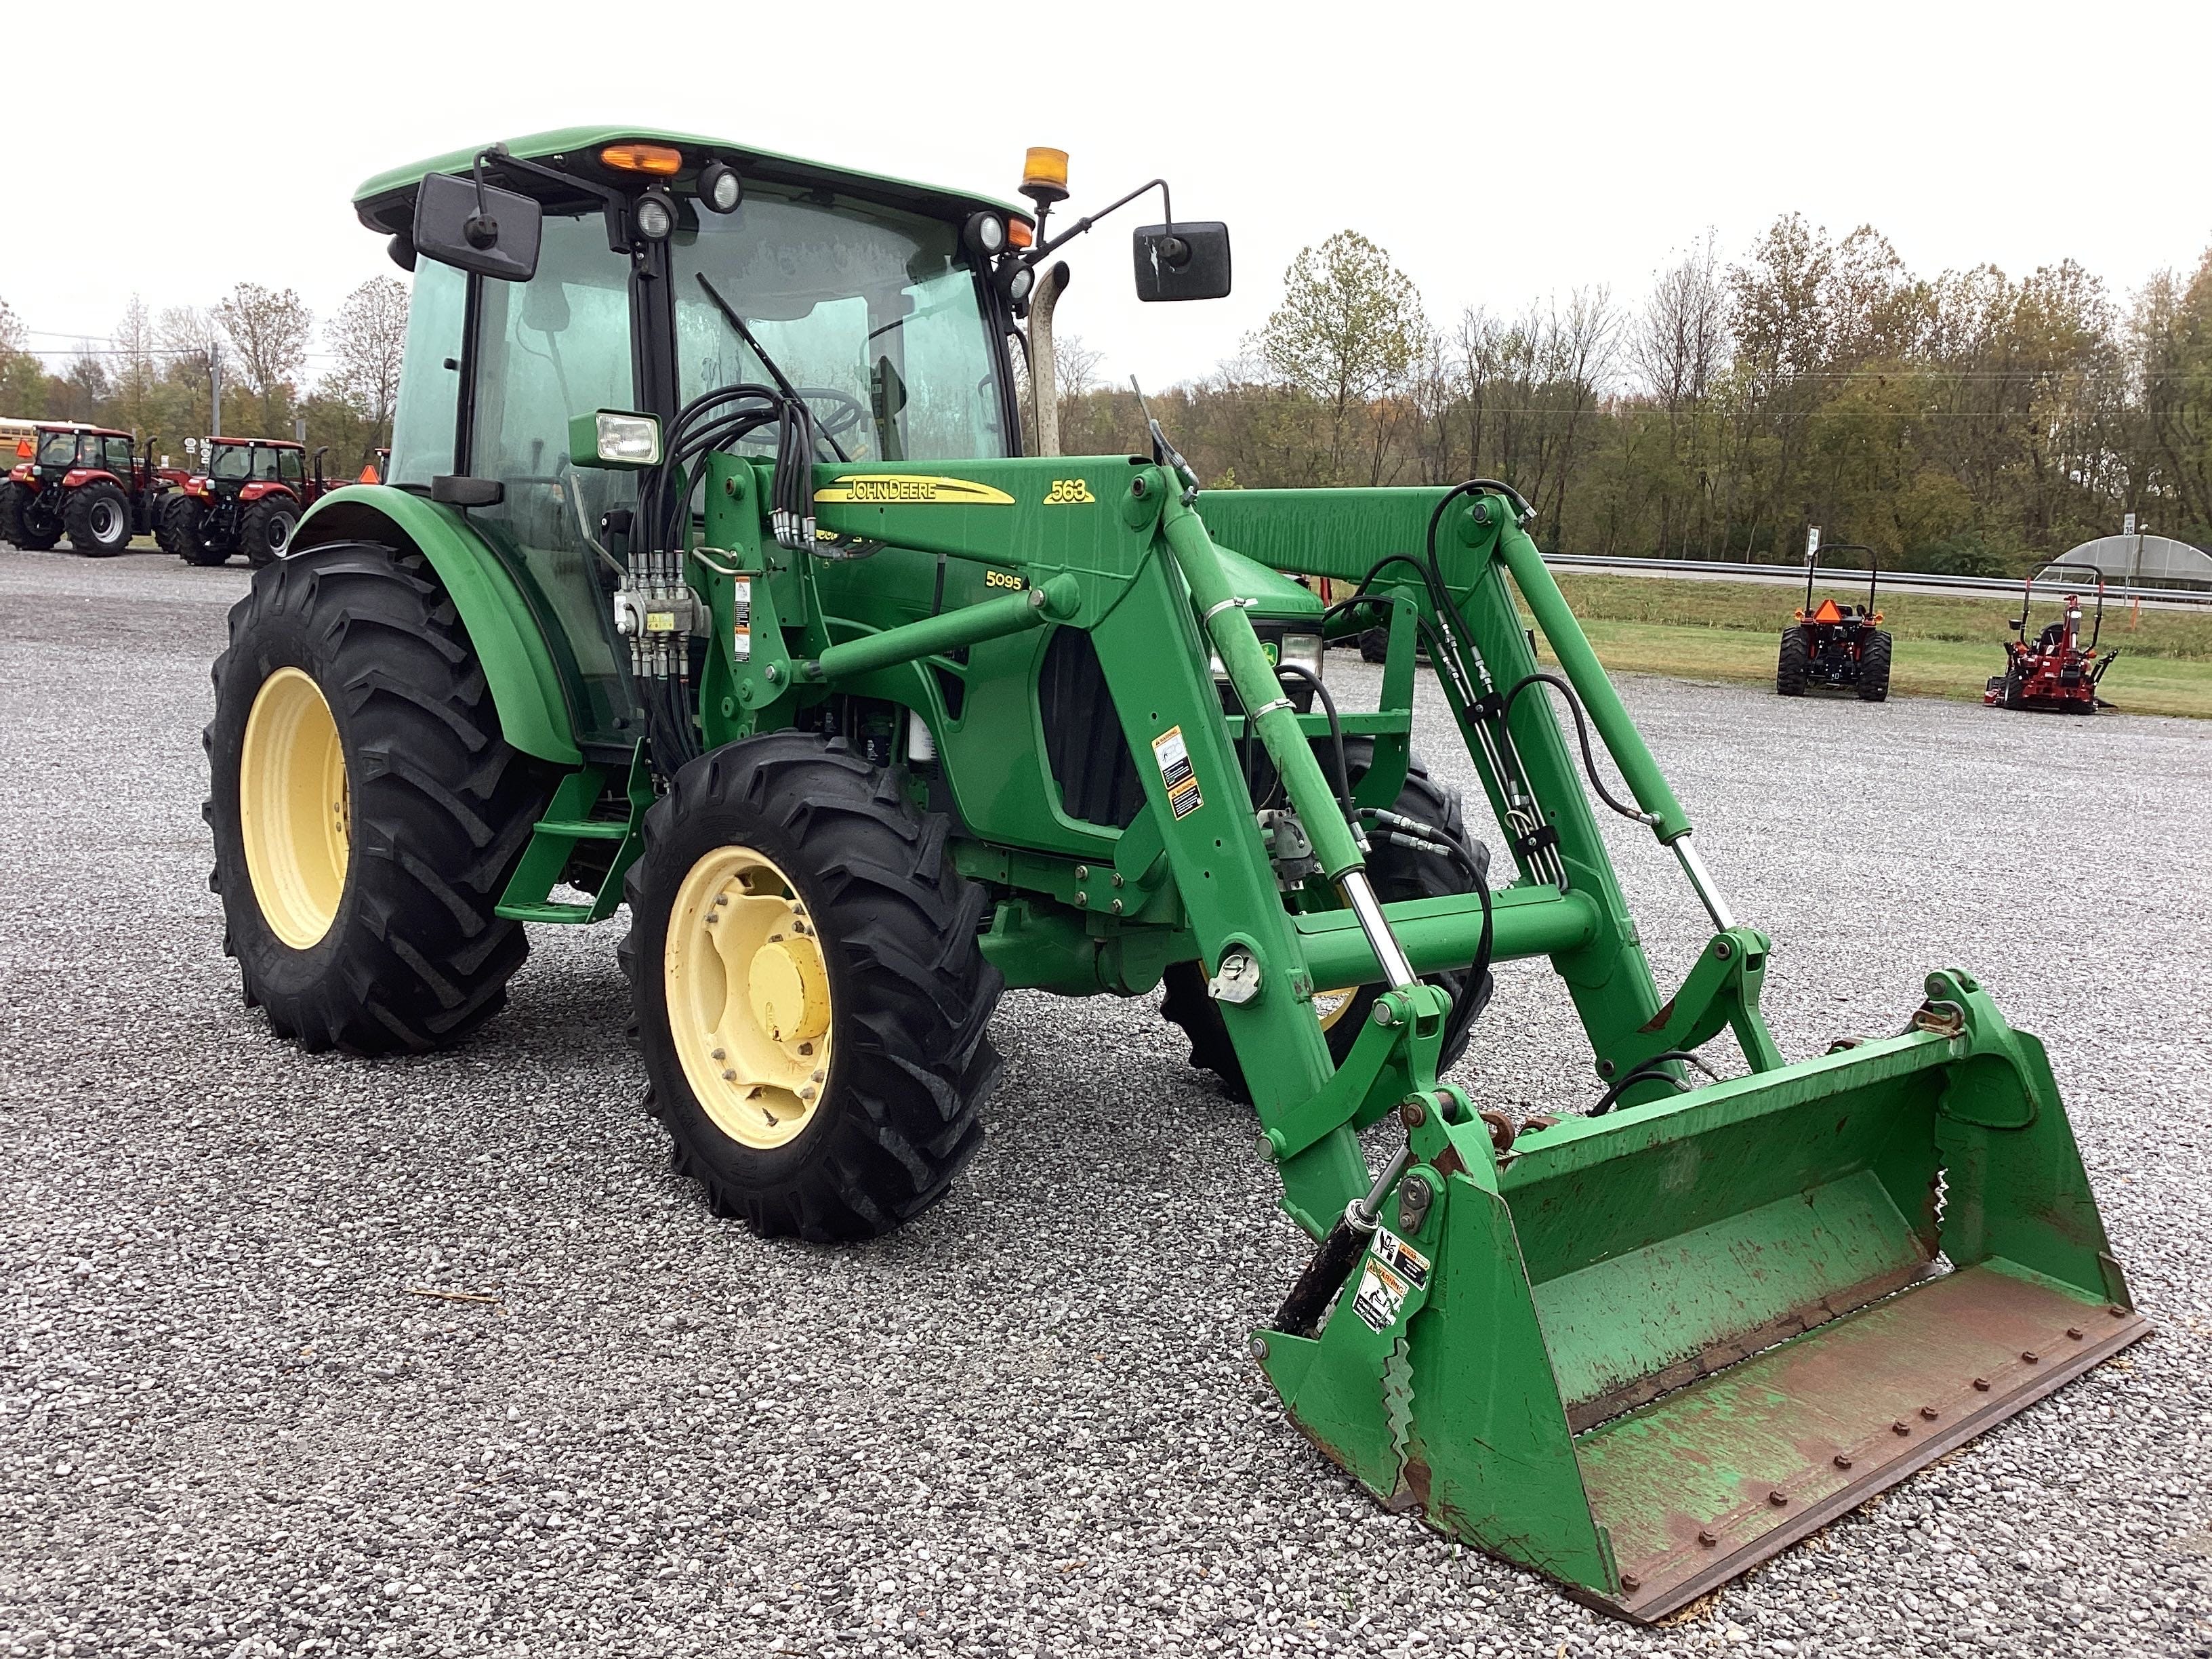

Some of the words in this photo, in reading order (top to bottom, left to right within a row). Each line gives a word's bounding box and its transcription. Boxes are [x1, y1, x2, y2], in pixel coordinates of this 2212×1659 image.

[847, 478, 888, 499] JOHN
[888, 478, 937, 499] DEERE
[1051, 478, 1086, 502] 563
[985, 570, 1022, 590] 5095
